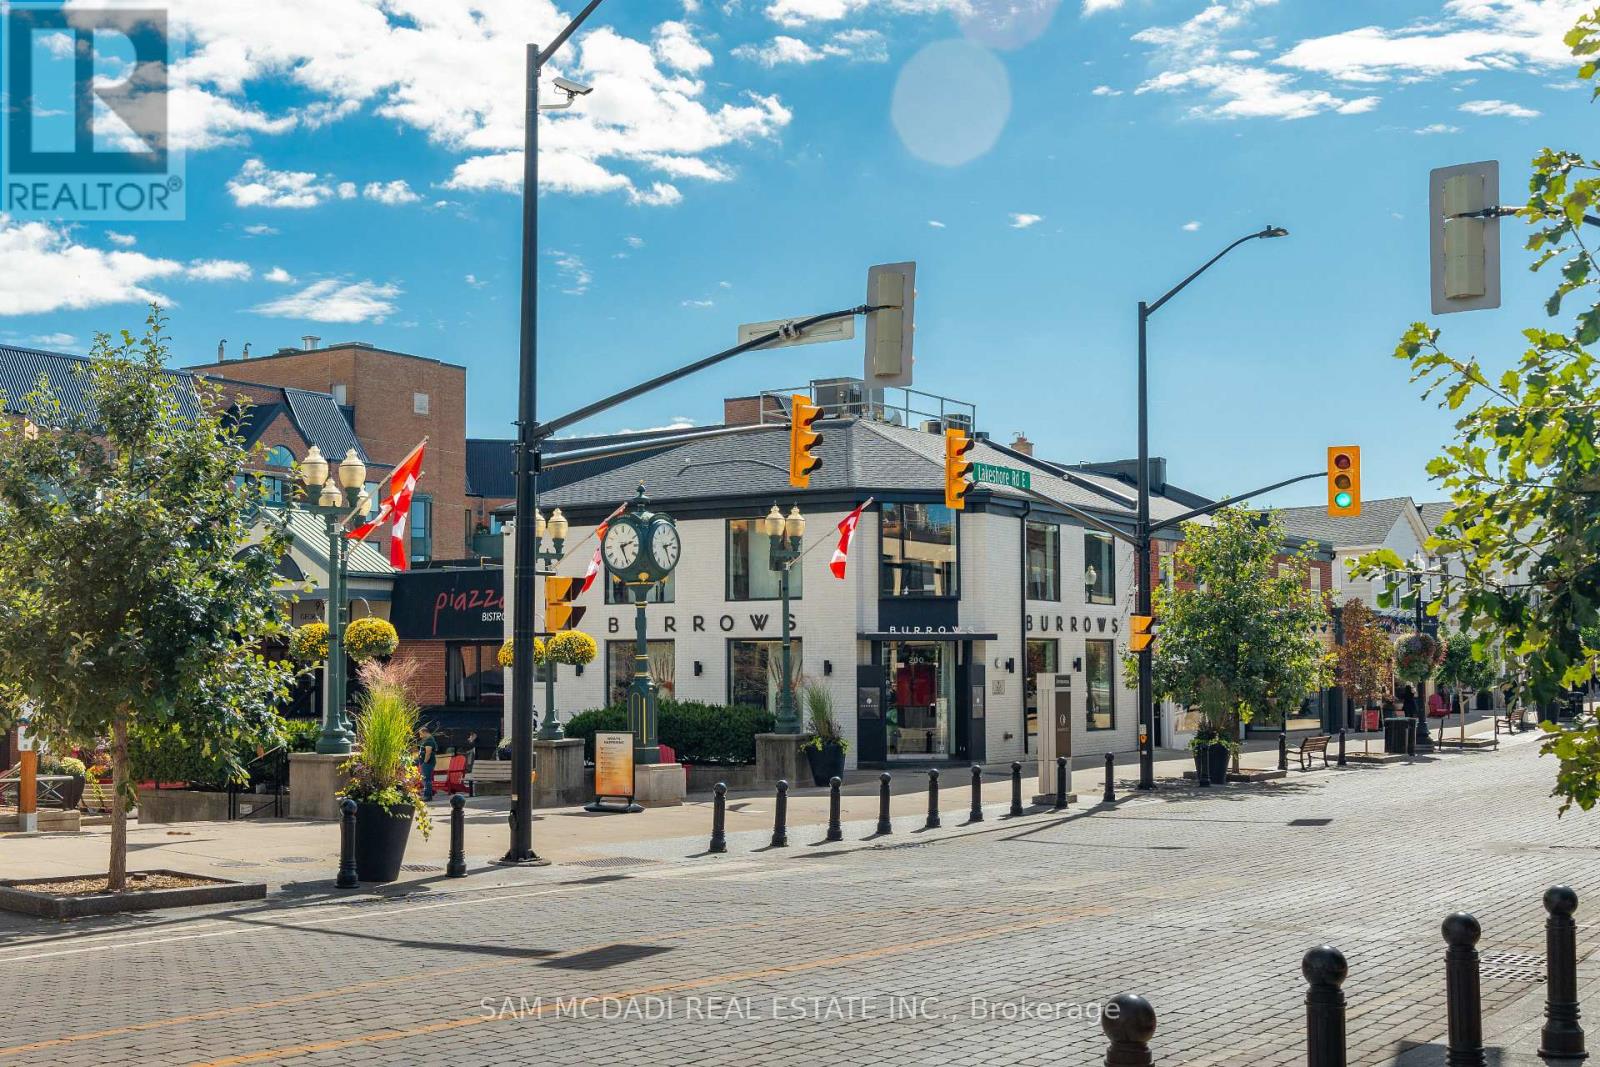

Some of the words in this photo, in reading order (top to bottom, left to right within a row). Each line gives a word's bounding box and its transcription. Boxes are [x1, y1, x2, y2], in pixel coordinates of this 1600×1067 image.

[978, 465, 1010, 485] Lakeshore
[1011, 471, 1020, 487] Rd
[1022, 472, 1026, 488] E
[608, 614, 797, 633] BRROWS
[889, 626, 975, 634] BURROWS
[1026, 614, 1118, 634] BURROWS
